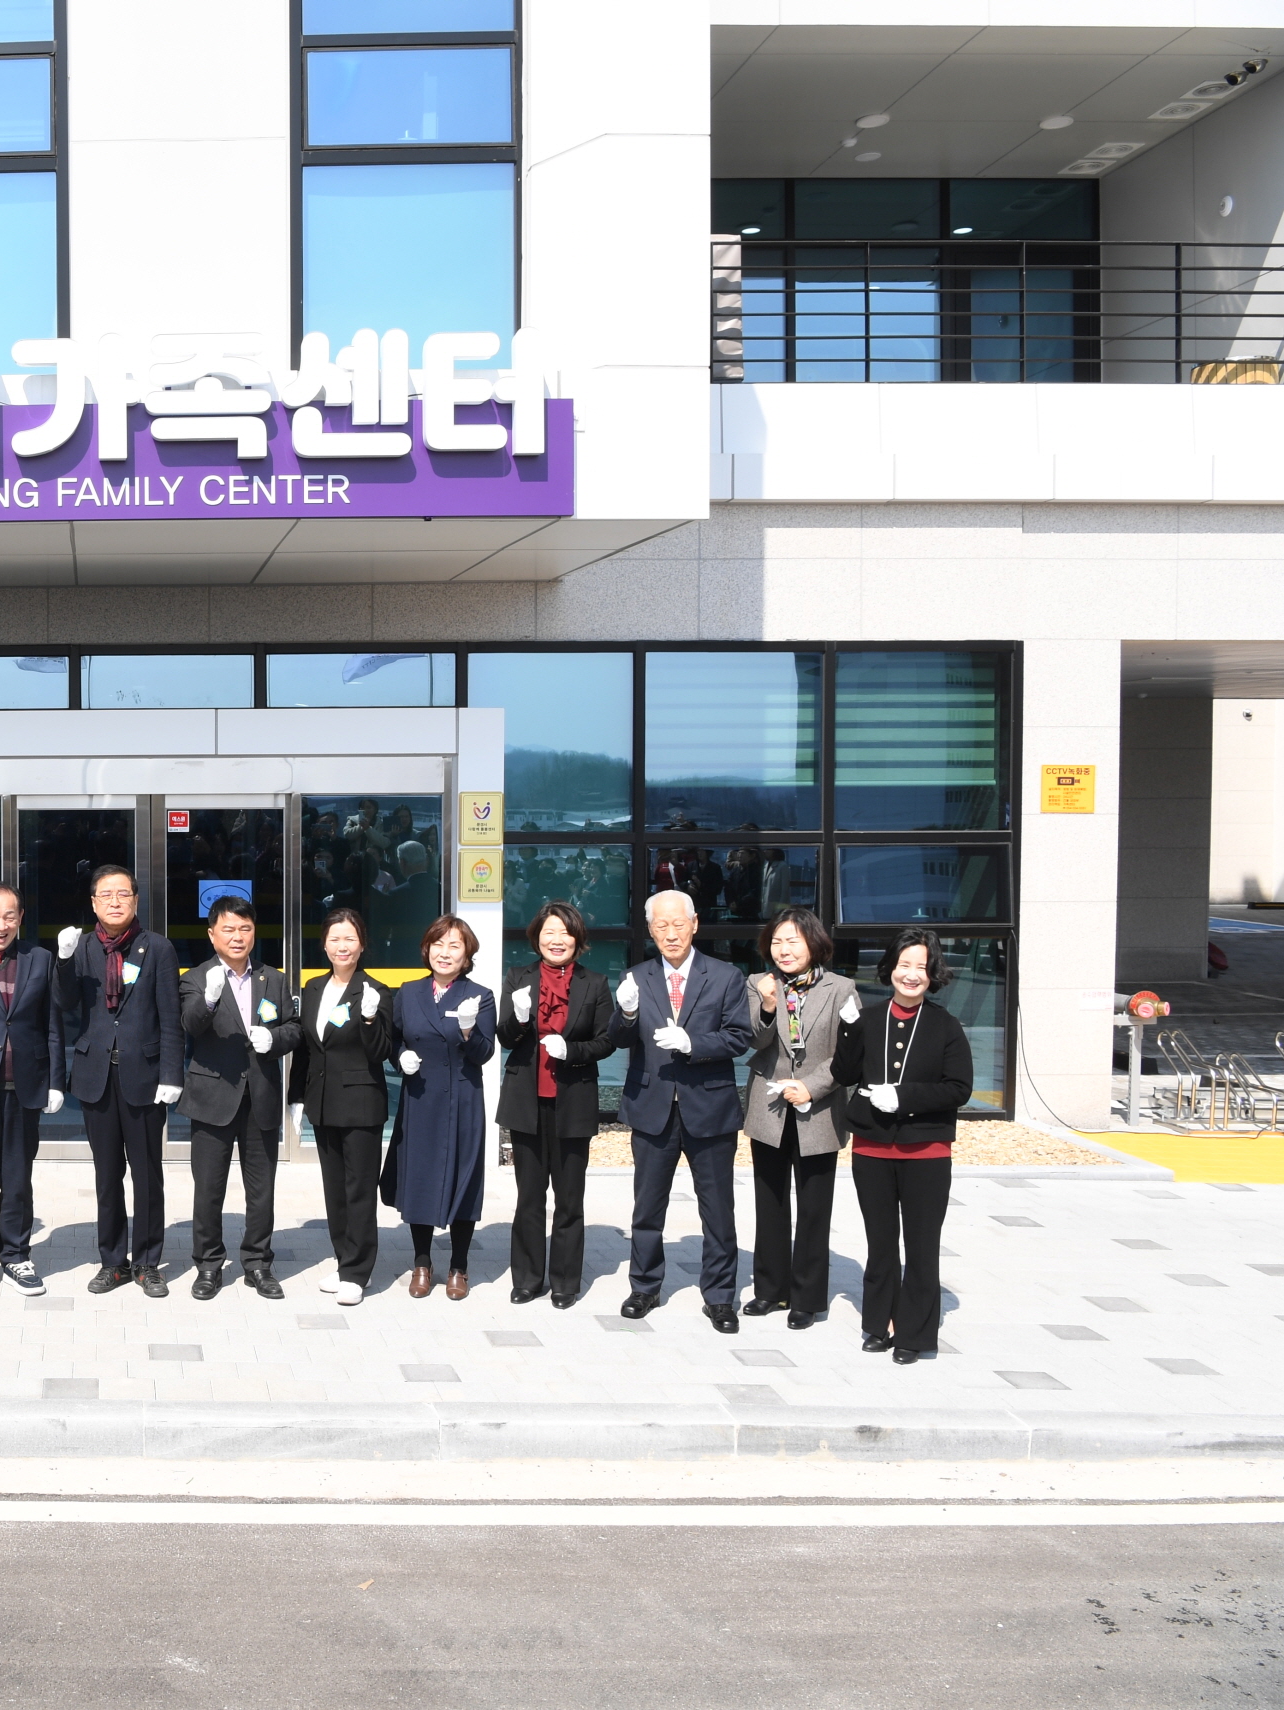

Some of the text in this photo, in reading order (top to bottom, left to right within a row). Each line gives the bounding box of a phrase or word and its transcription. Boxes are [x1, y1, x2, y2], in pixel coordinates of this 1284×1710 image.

[57, 476, 184, 507] FAMILY
[199, 475, 351, 505] CENTER
[1046, 767, 1090, 775] CCTV녹화중
